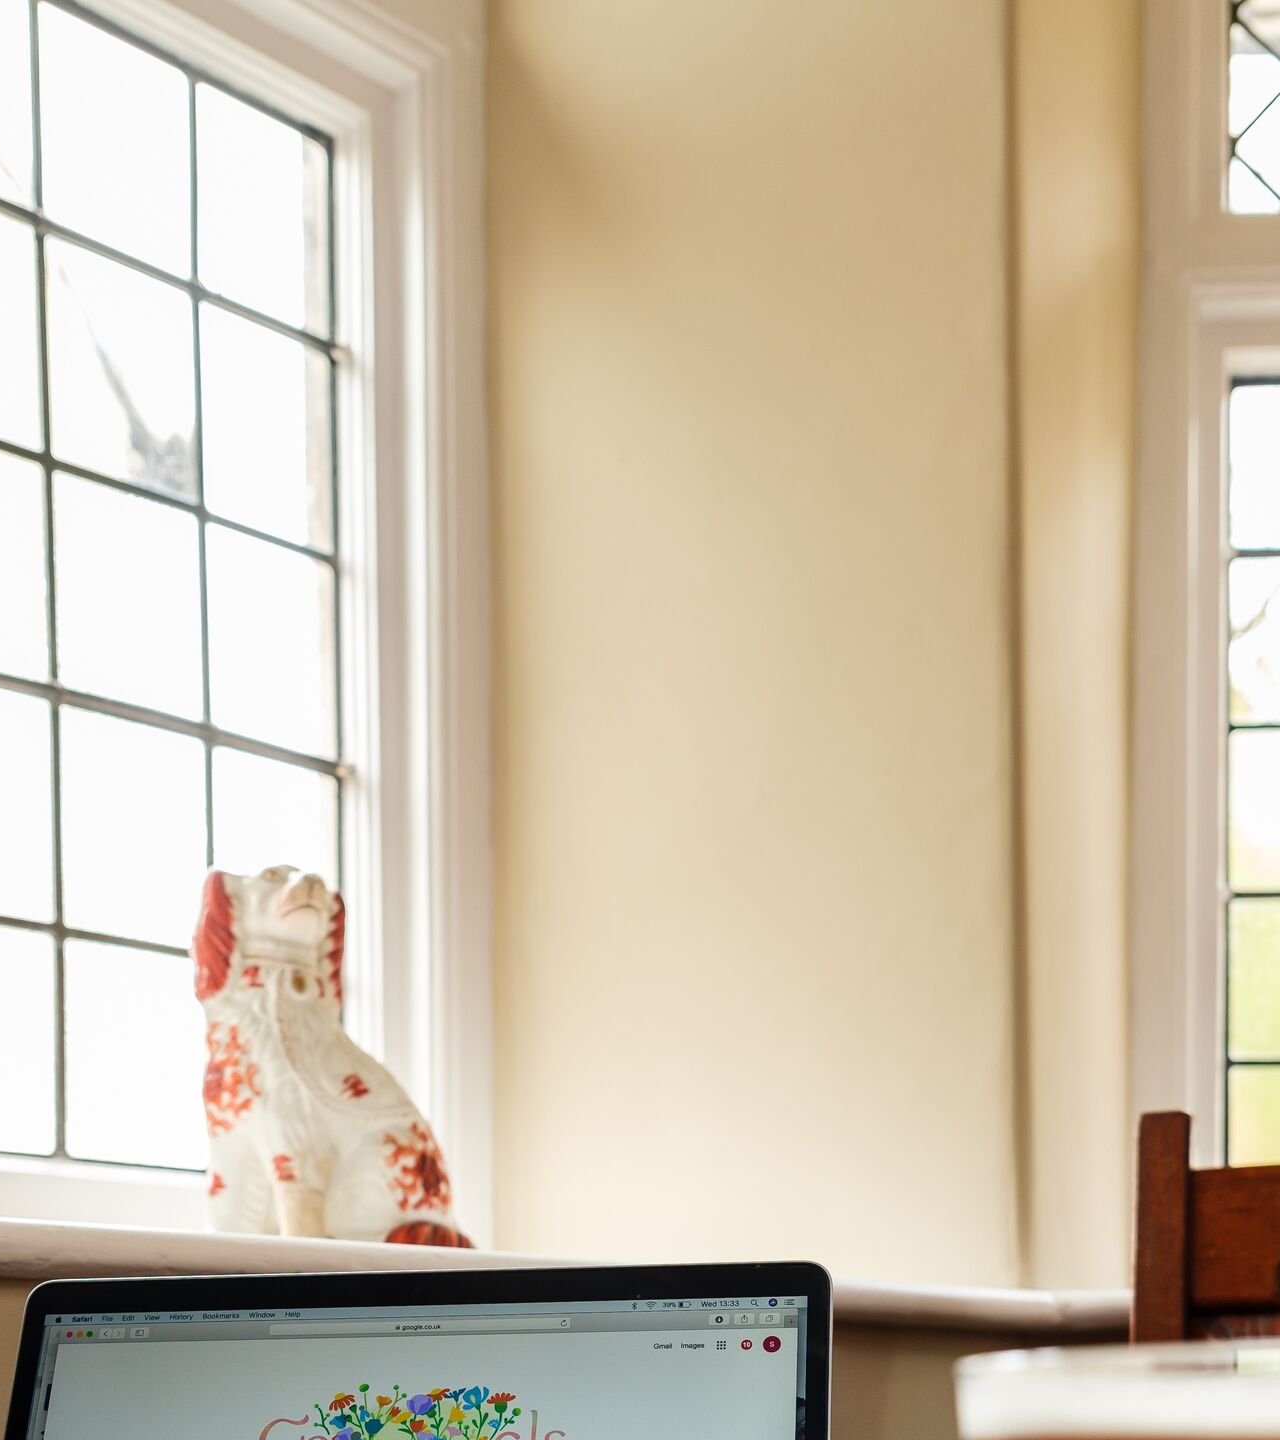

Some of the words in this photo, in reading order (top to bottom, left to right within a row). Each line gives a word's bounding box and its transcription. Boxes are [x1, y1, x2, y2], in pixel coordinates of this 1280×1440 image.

[700, 1300, 718, 1308] Wed
[719, 1300, 740, 1308] 13:33
[121, 1314, 135, 1322] Edit
[144, 1314, 161, 1322] View
[169, 1313, 194, 1321] History
[202, 1312, 240, 1320] Bookmarks
[248, 1310, 277, 1319] Window
[284, 1310, 301, 1319] Help
[401, 1323, 441, 1332] google.co.uk
[653, 1342, 673, 1350] Gmail
[680, 1342, 705, 1351] Images
